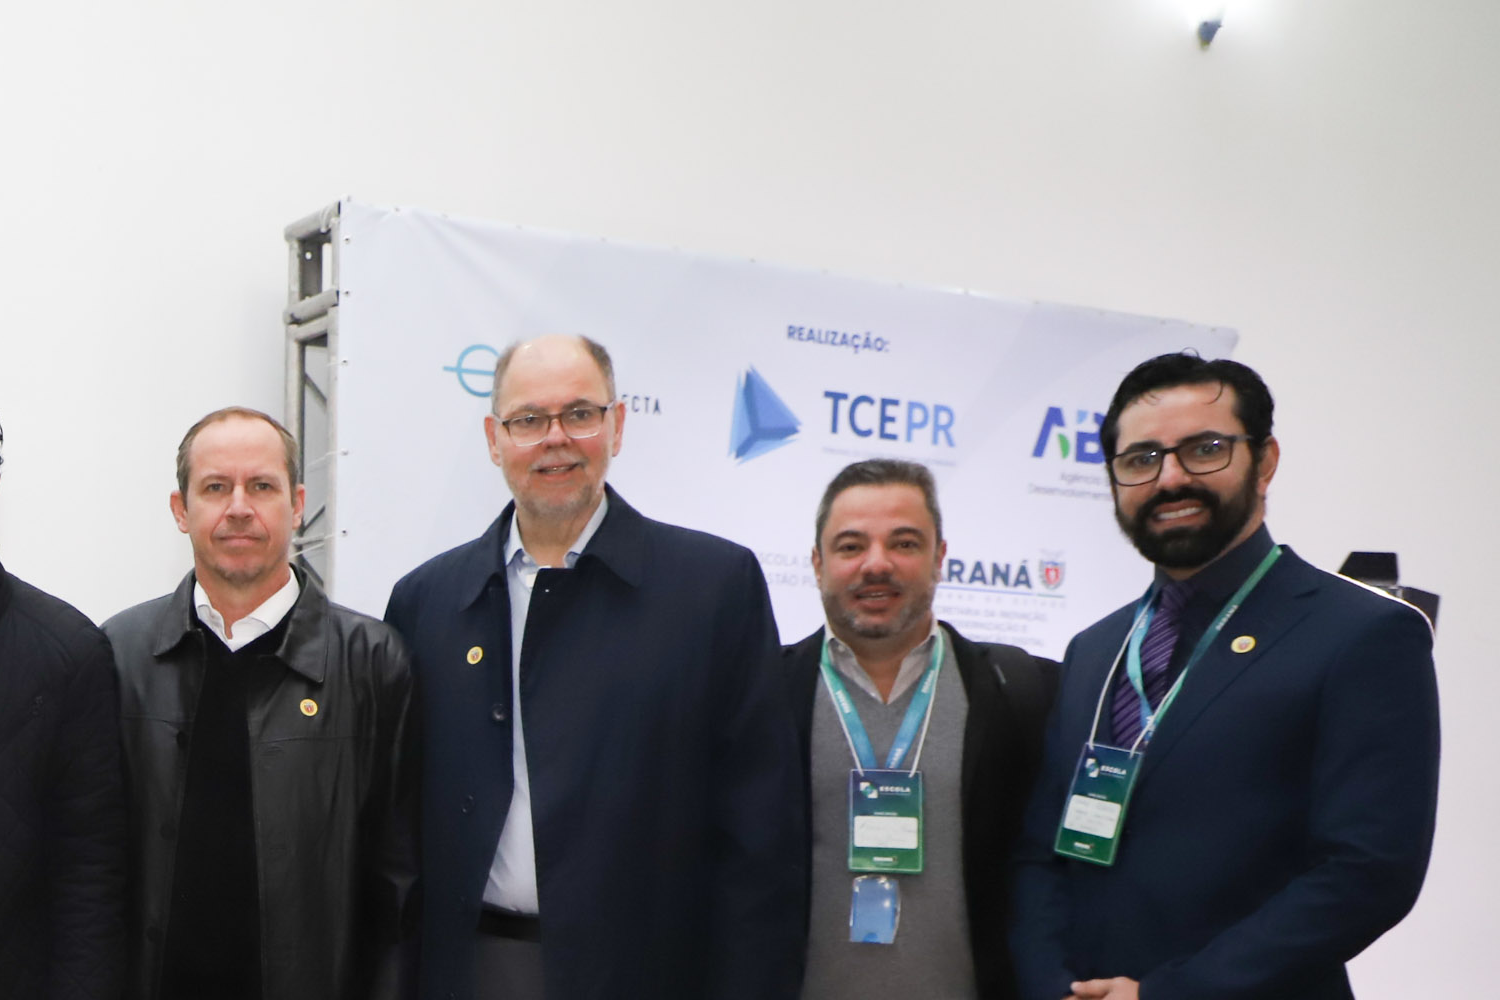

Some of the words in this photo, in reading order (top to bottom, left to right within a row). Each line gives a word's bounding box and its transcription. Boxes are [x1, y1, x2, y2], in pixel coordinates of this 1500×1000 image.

[787, 324, 890, 354] REALIZAÇÃO:
[823, 390, 955, 448] TCEPR
[942, 558, 1033, 590] RANÁ
